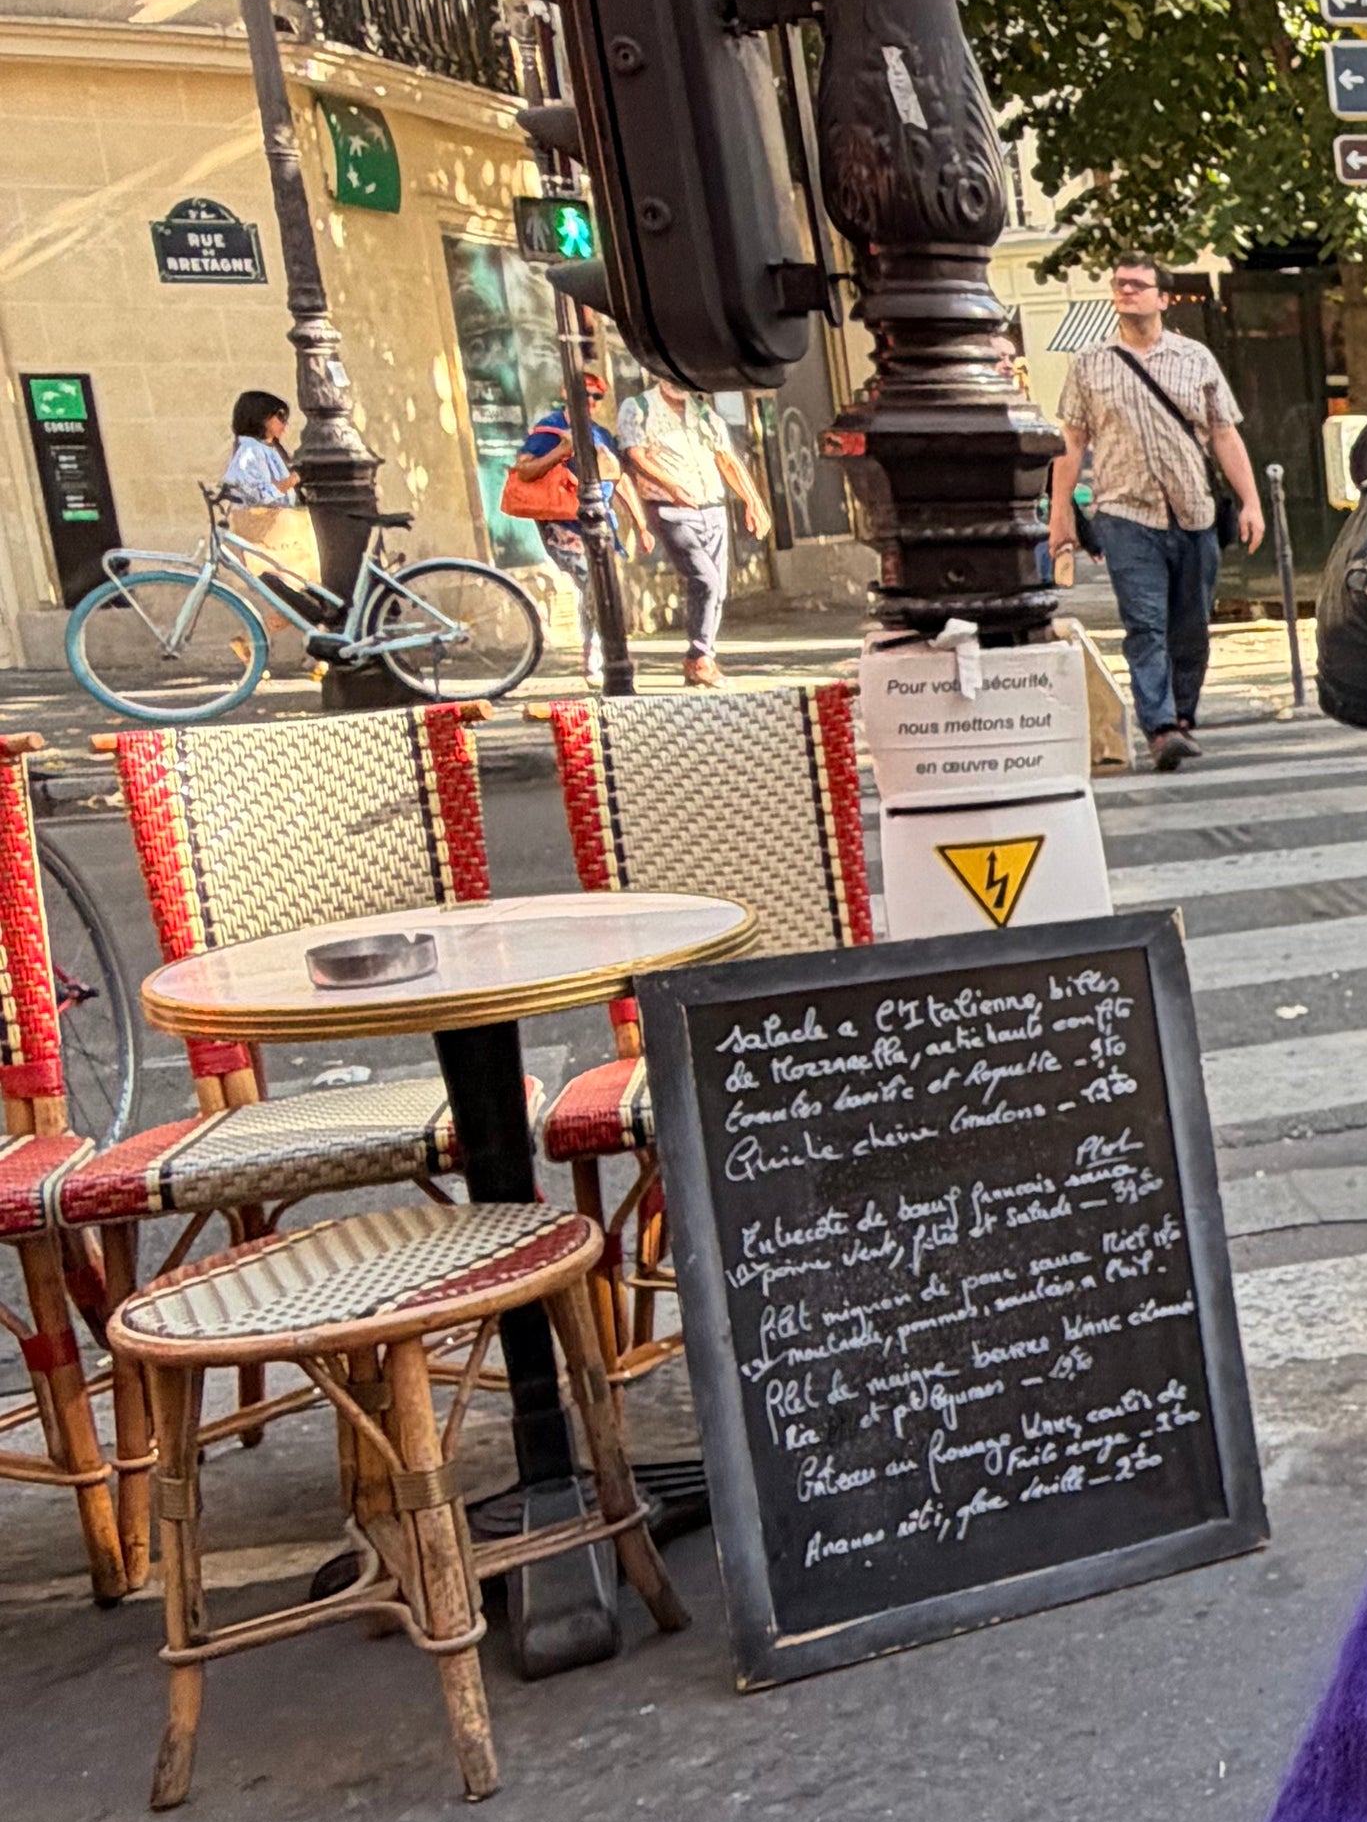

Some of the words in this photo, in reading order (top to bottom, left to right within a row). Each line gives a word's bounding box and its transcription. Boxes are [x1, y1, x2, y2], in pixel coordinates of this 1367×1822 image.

[186, 232, 226, 249] RUE
[166, 257, 255, 273] BRETAGNE
[887, 679, 927, 696] Pour
[981, 673, 1053, 691] sécurité,
[898, 721, 939, 736] nous
[944, 716, 1015, 734] mettons
[1019, 713, 1052, 729] tout
[916, 762, 937, 775] en
[1004, 754, 1043, 773] pour
[724, 1060, 760, 1093] de
[856, 1200, 888, 1231] de
[920, 1272, 950, 1302] de
[826, 1368, 860, 1405] de
